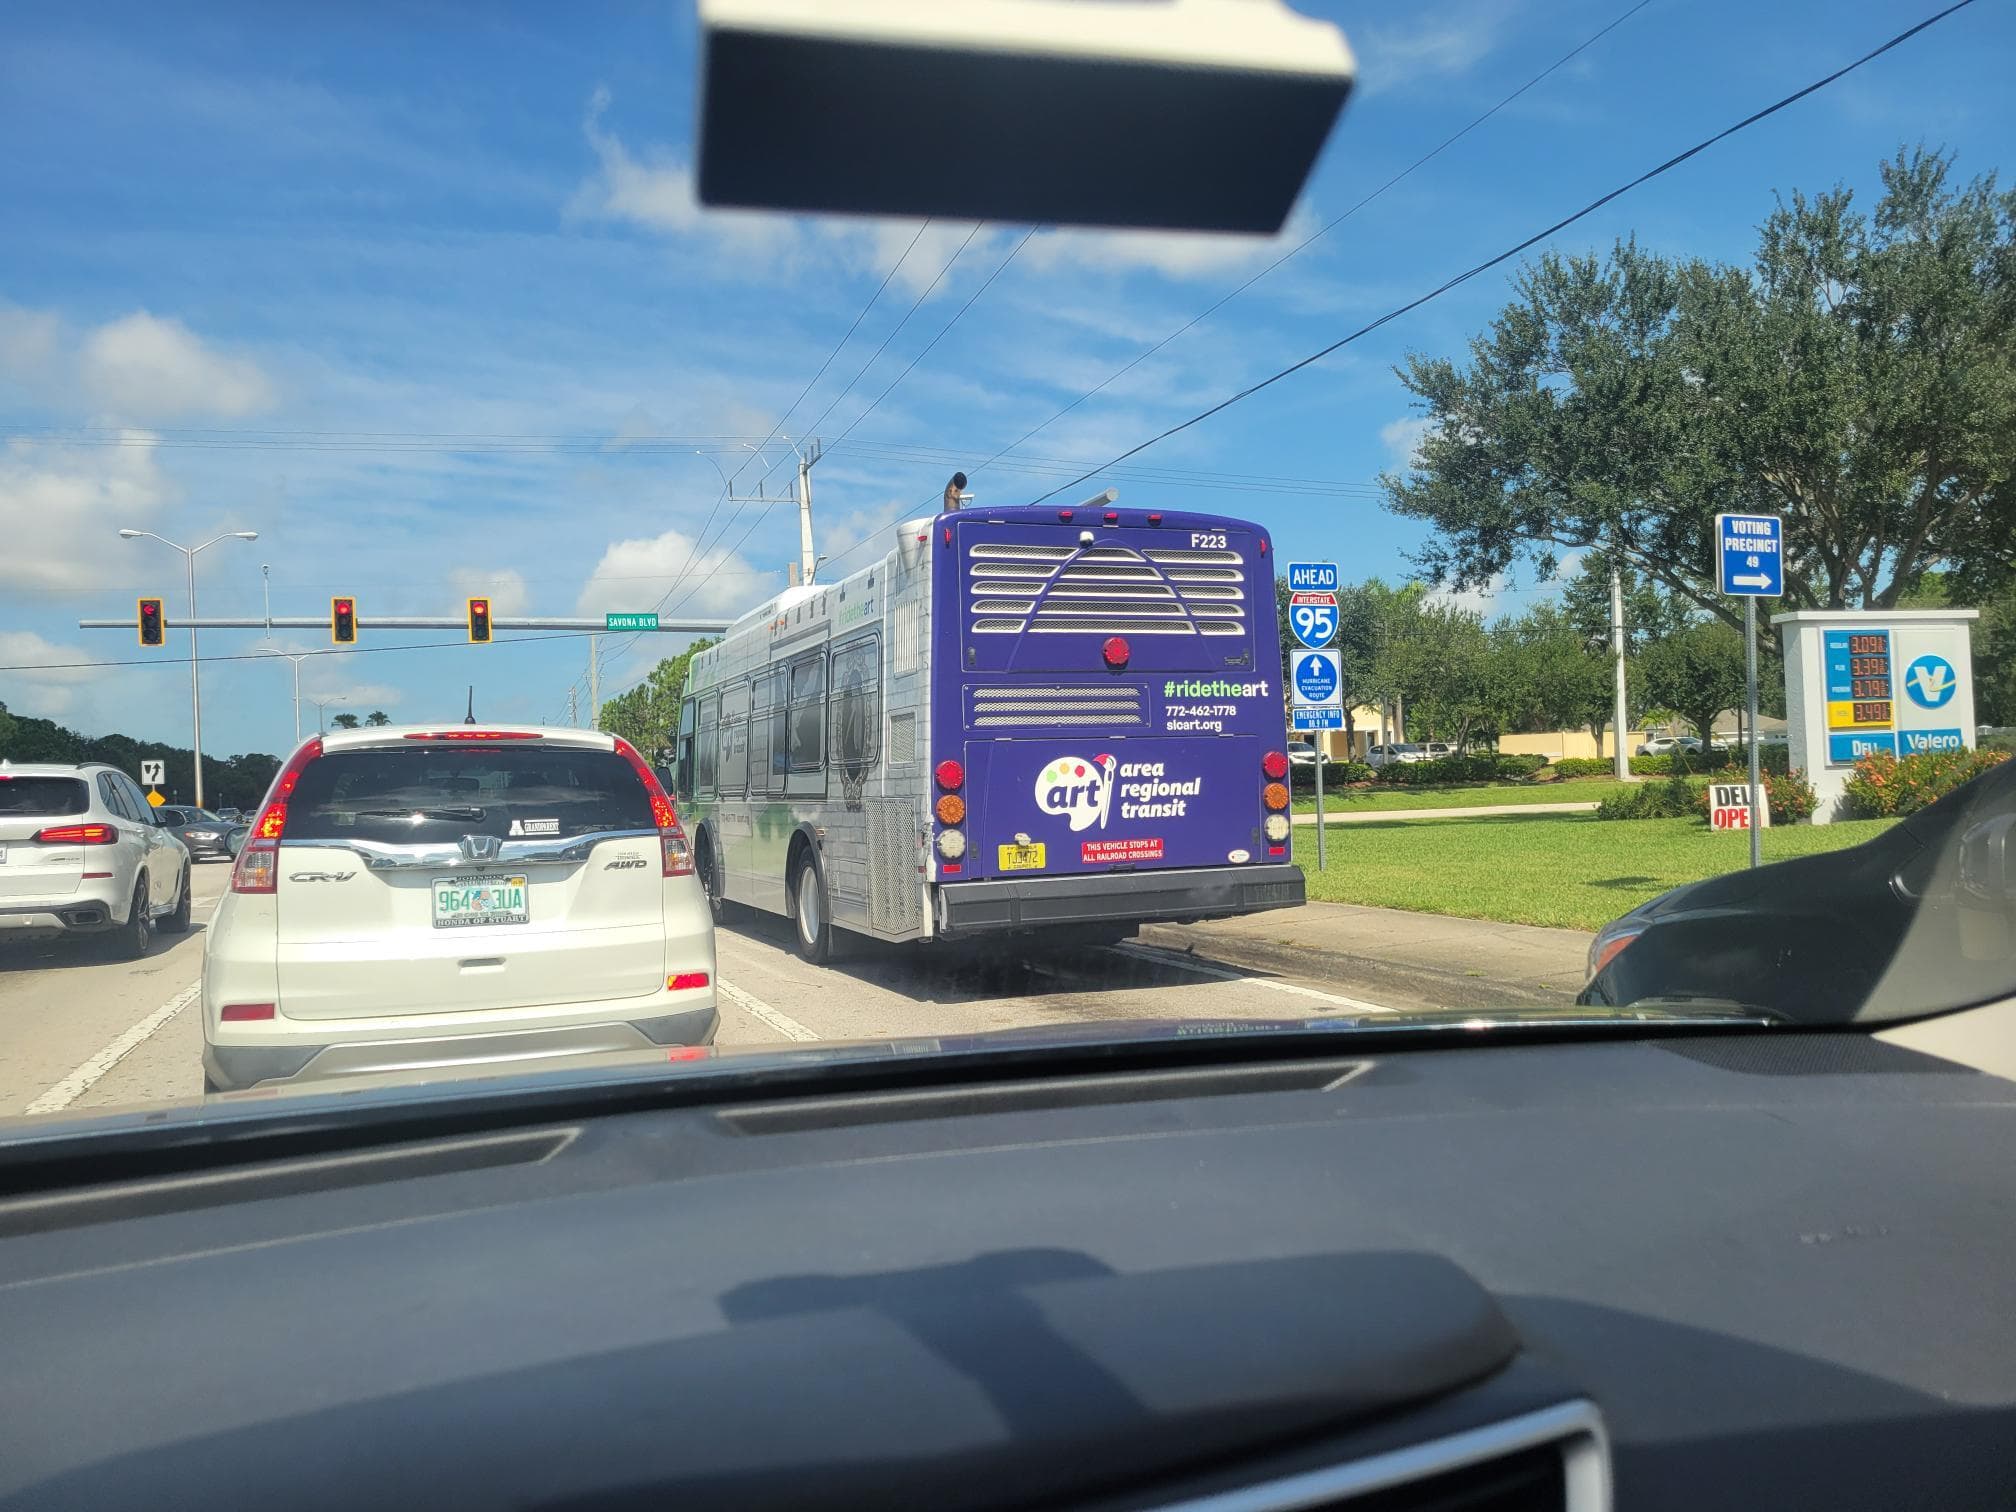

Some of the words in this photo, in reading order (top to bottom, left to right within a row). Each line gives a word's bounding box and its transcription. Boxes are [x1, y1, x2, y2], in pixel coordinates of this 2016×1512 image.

[1731, 520, 1772, 535] VOTING
[1191, 533, 1227, 549] F223
[1724, 538, 1778, 553] PRECINCT
[1293, 568, 1335, 585] AHEAD
[1296, 596, 1331, 604] INTERSTATE
[608, 617, 637, 627] SAVONA
[639, 617, 657, 627] BLVD
[1295, 607, 1333, 639] 95
[1164, 680, 1269, 697] #ridetheart
[1165, 705, 1237, 717] 772-462-1778
[1166, 720, 1222, 733] slcart.org
[1906, 732, 1960, 750] Valero
[1120, 762, 1164, 778] area
[1046, 779, 1101, 809] art
[1120, 777, 1202, 802] regional
[1715, 786, 1752, 807] DEL
[1121, 799, 1187, 819] transit
[1714, 807, 1762, 829] OPE
[1086, 843, 1101, 852] THIS
[1102, 841, 1128, 851] VEHICLE
[1129, 840, 1149, 849] STOPS
[1149, 839, 1158, 848] AT
[1083, 853, 1096, 862] ALL
[1096, 850, 1127, 861] RAILROAD
[1128, 849, 1162, 859] CROSSINGS
[603, 859, 648, 871] AWD
[289, 871, 358, 883] CR-V
[437, 918, 471, 927] HONDA
[473, 917, 487, 925] OF
[489, 915, 525, 924] STUART
